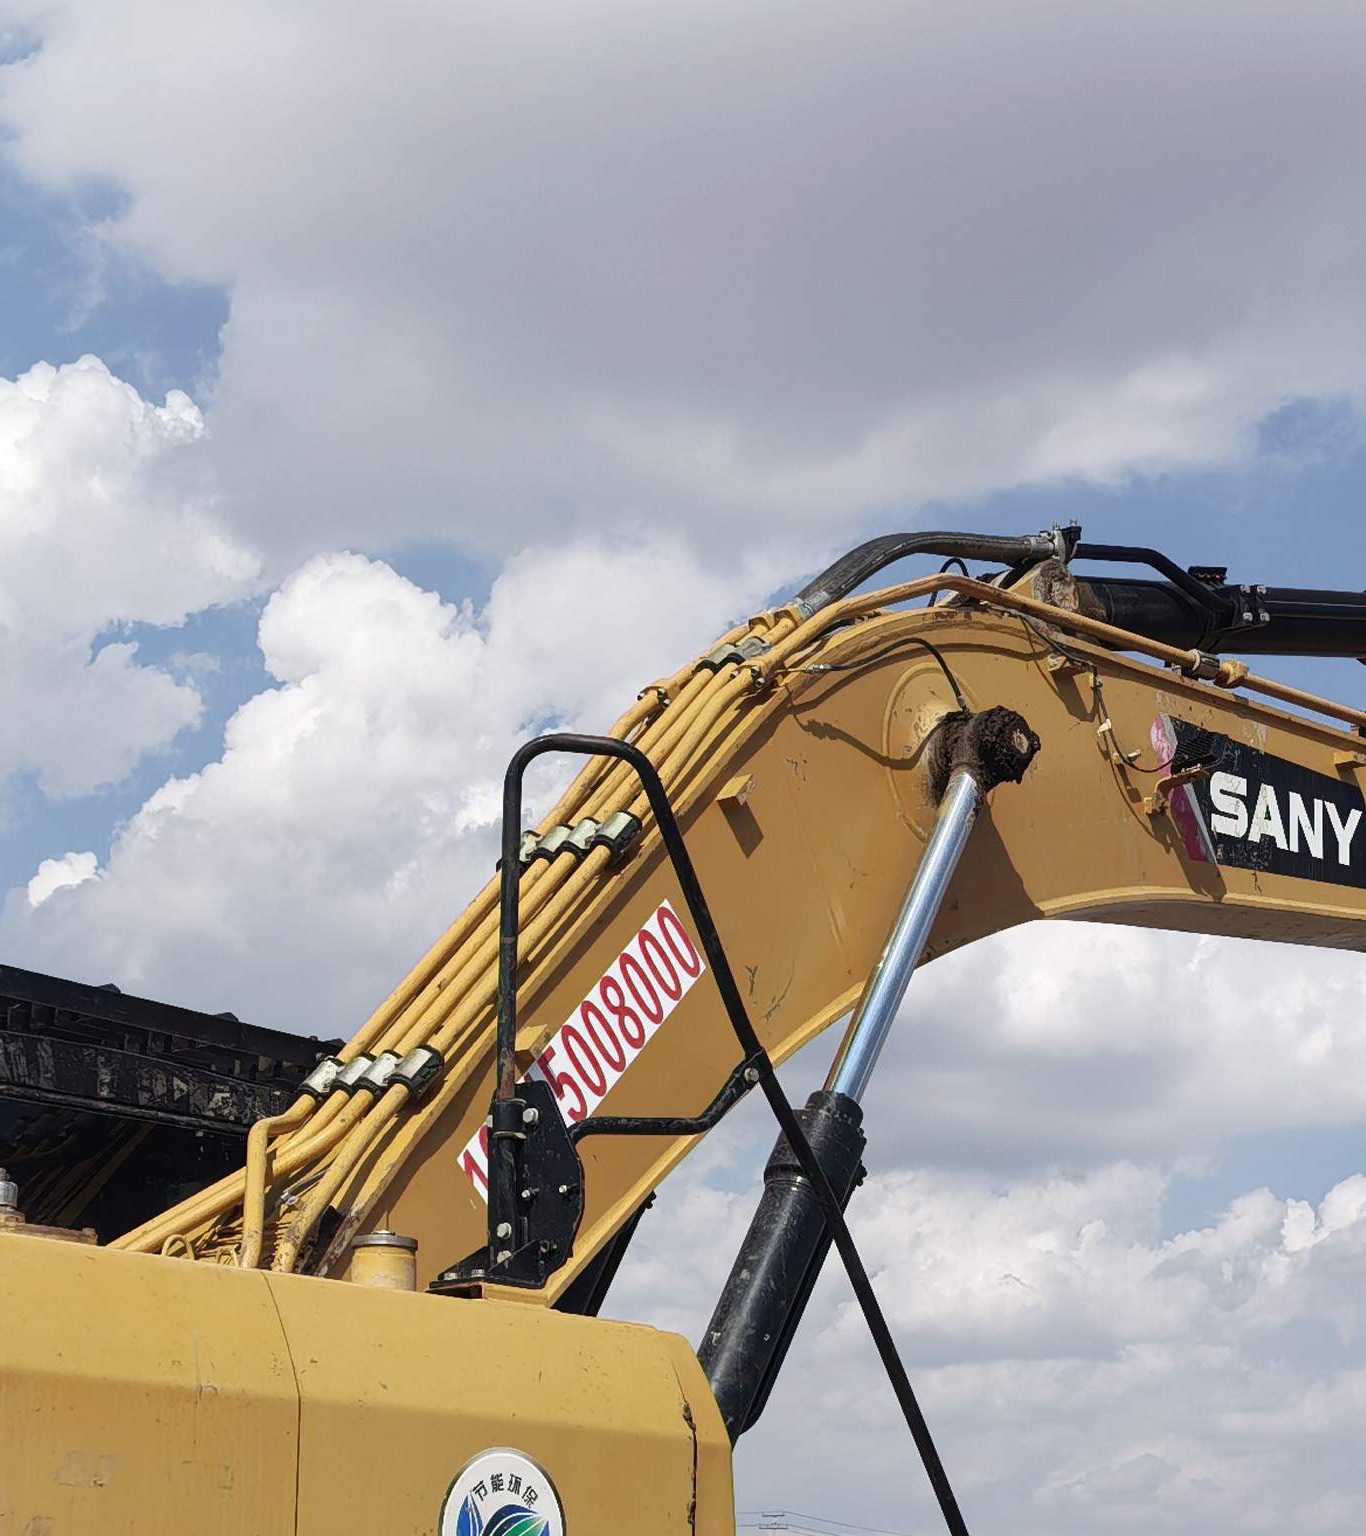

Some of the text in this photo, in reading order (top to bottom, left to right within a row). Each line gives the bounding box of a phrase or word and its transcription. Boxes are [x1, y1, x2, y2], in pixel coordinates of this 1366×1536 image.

[1209, 771, 1363, 866] SANY
[472, 1473, 539, 1508] 节能环保
